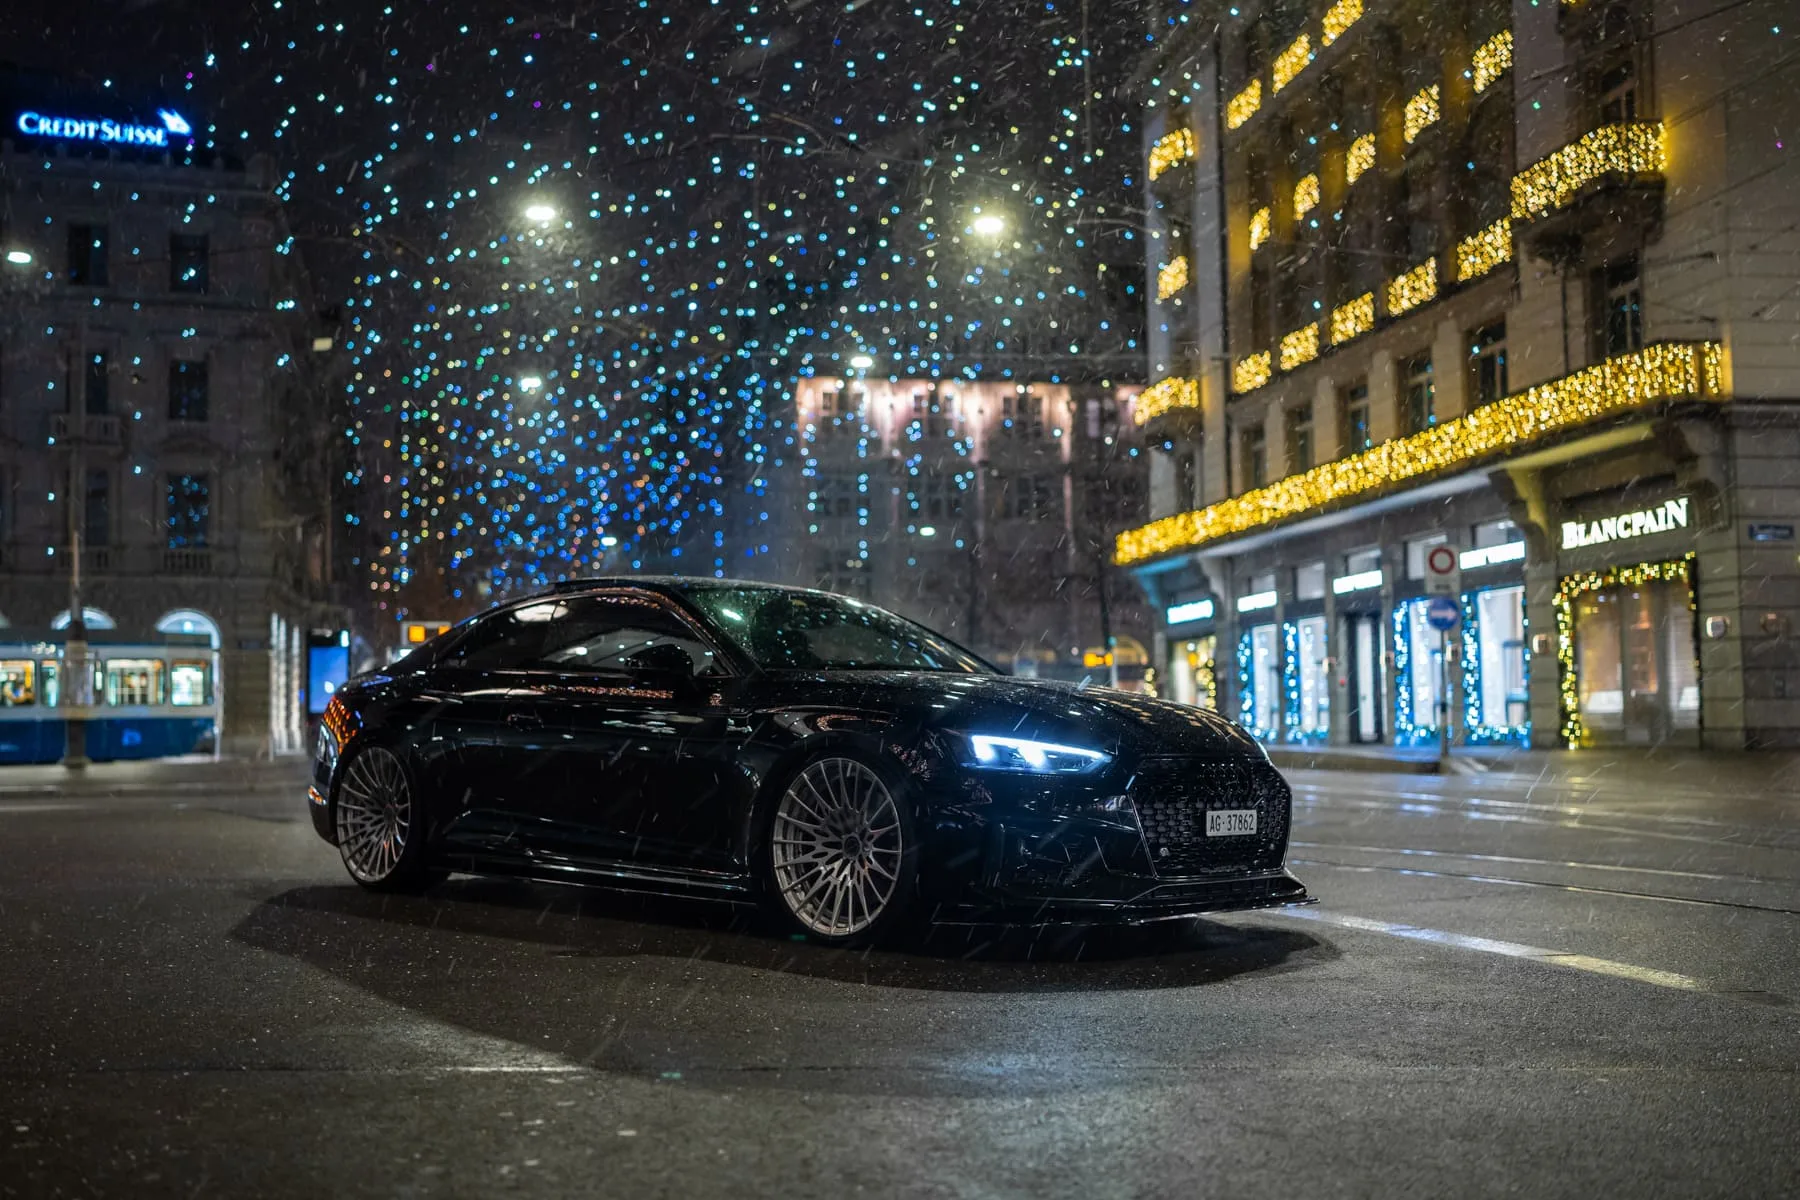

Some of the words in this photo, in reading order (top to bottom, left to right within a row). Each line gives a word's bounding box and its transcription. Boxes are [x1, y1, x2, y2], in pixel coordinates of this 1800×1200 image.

[18, 111, 99, 139] CREDIT
[99, 118, 168, 147] SUISSE
[1562, 498, 1688, 549] BLANCPAIN
